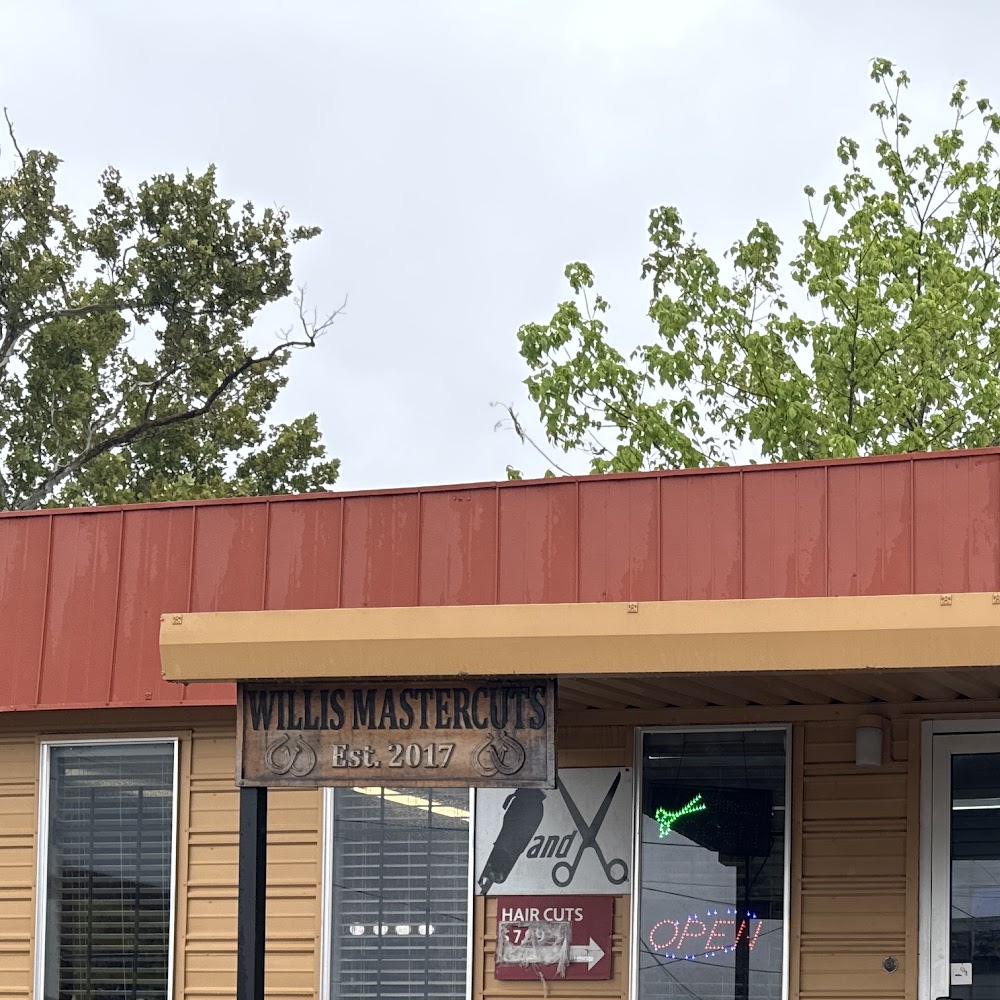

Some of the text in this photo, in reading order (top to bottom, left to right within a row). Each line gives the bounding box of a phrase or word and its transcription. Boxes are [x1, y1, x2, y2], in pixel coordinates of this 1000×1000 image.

[249, 685, 547, 731] WILLIS MASTERCUTS
[331, 743, 455, 768] Est. 2017
[526, 830, 577, 859] and
[502, 907, 584, 922] HAIR CUTS
[649, 919, 763, 951] OPEN
